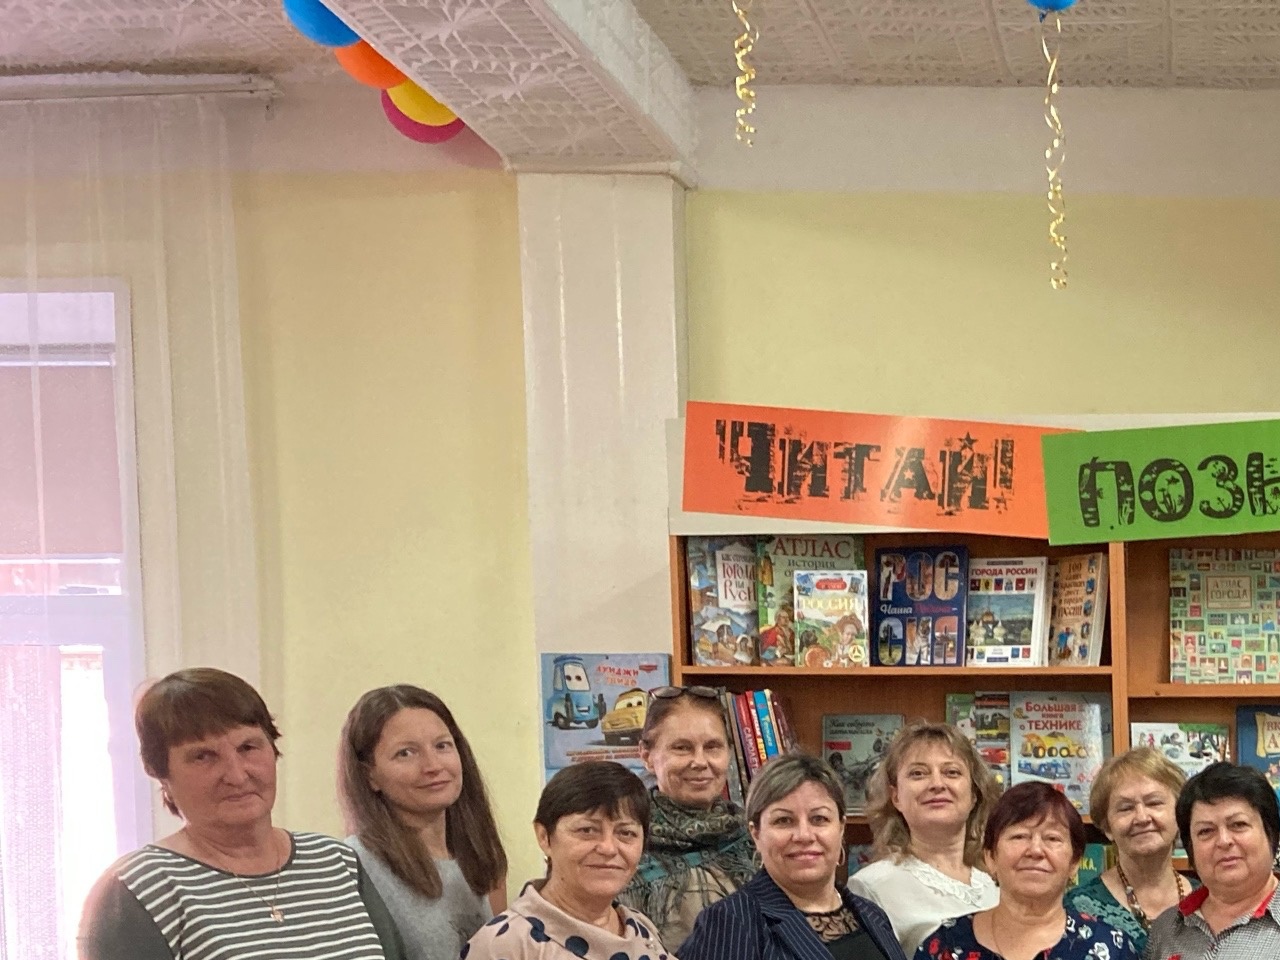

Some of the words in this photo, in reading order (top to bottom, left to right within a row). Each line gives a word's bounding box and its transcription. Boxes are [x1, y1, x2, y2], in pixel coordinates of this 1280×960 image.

[715, 419, 1015, 516] ЧИТАЙ!
[772, 537, 852, 559] АТЛАС
[971, 567, 1004, 576] ГОРОДА
[1005, 567, 1038, 576] РОССИИ
[880, 603, 913, 615] Наша
[1026, 720, 1083, 731] ТЕХНИКЕ
